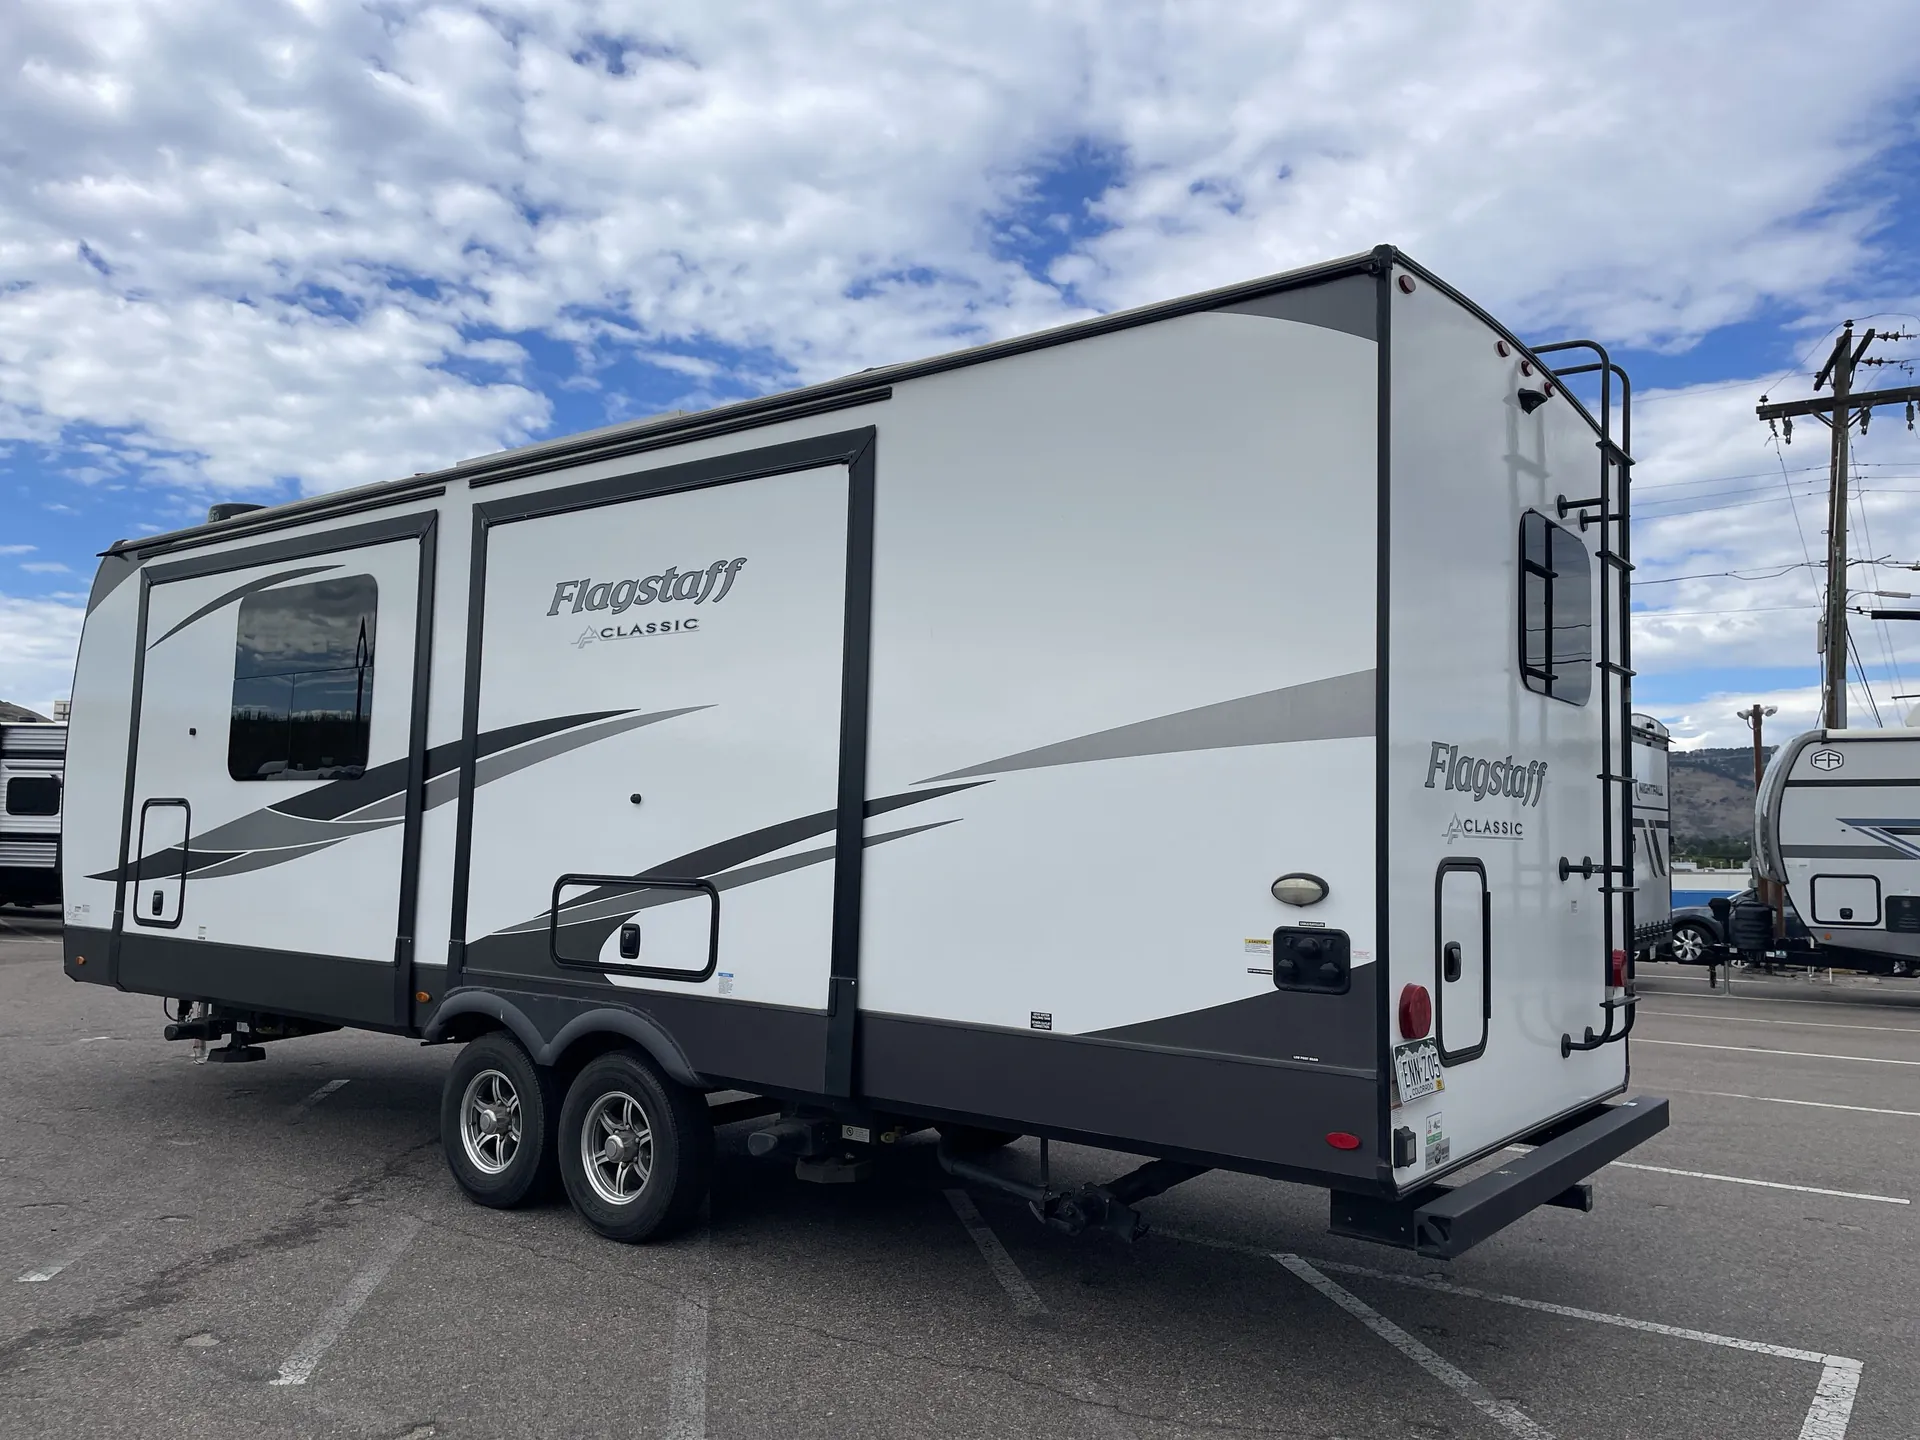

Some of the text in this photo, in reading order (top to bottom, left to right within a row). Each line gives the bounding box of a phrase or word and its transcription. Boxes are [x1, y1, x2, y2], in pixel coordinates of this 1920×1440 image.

[547, 557, 748, 617] Flagstaff
[600, 618, 700, 638] CLASSIC
[1424, 741, 1549, 808] Flagstaff
[1463, 819, 1524, 836] CLASSIC
[1411, 1082, 1434, 1096] COLORADO
